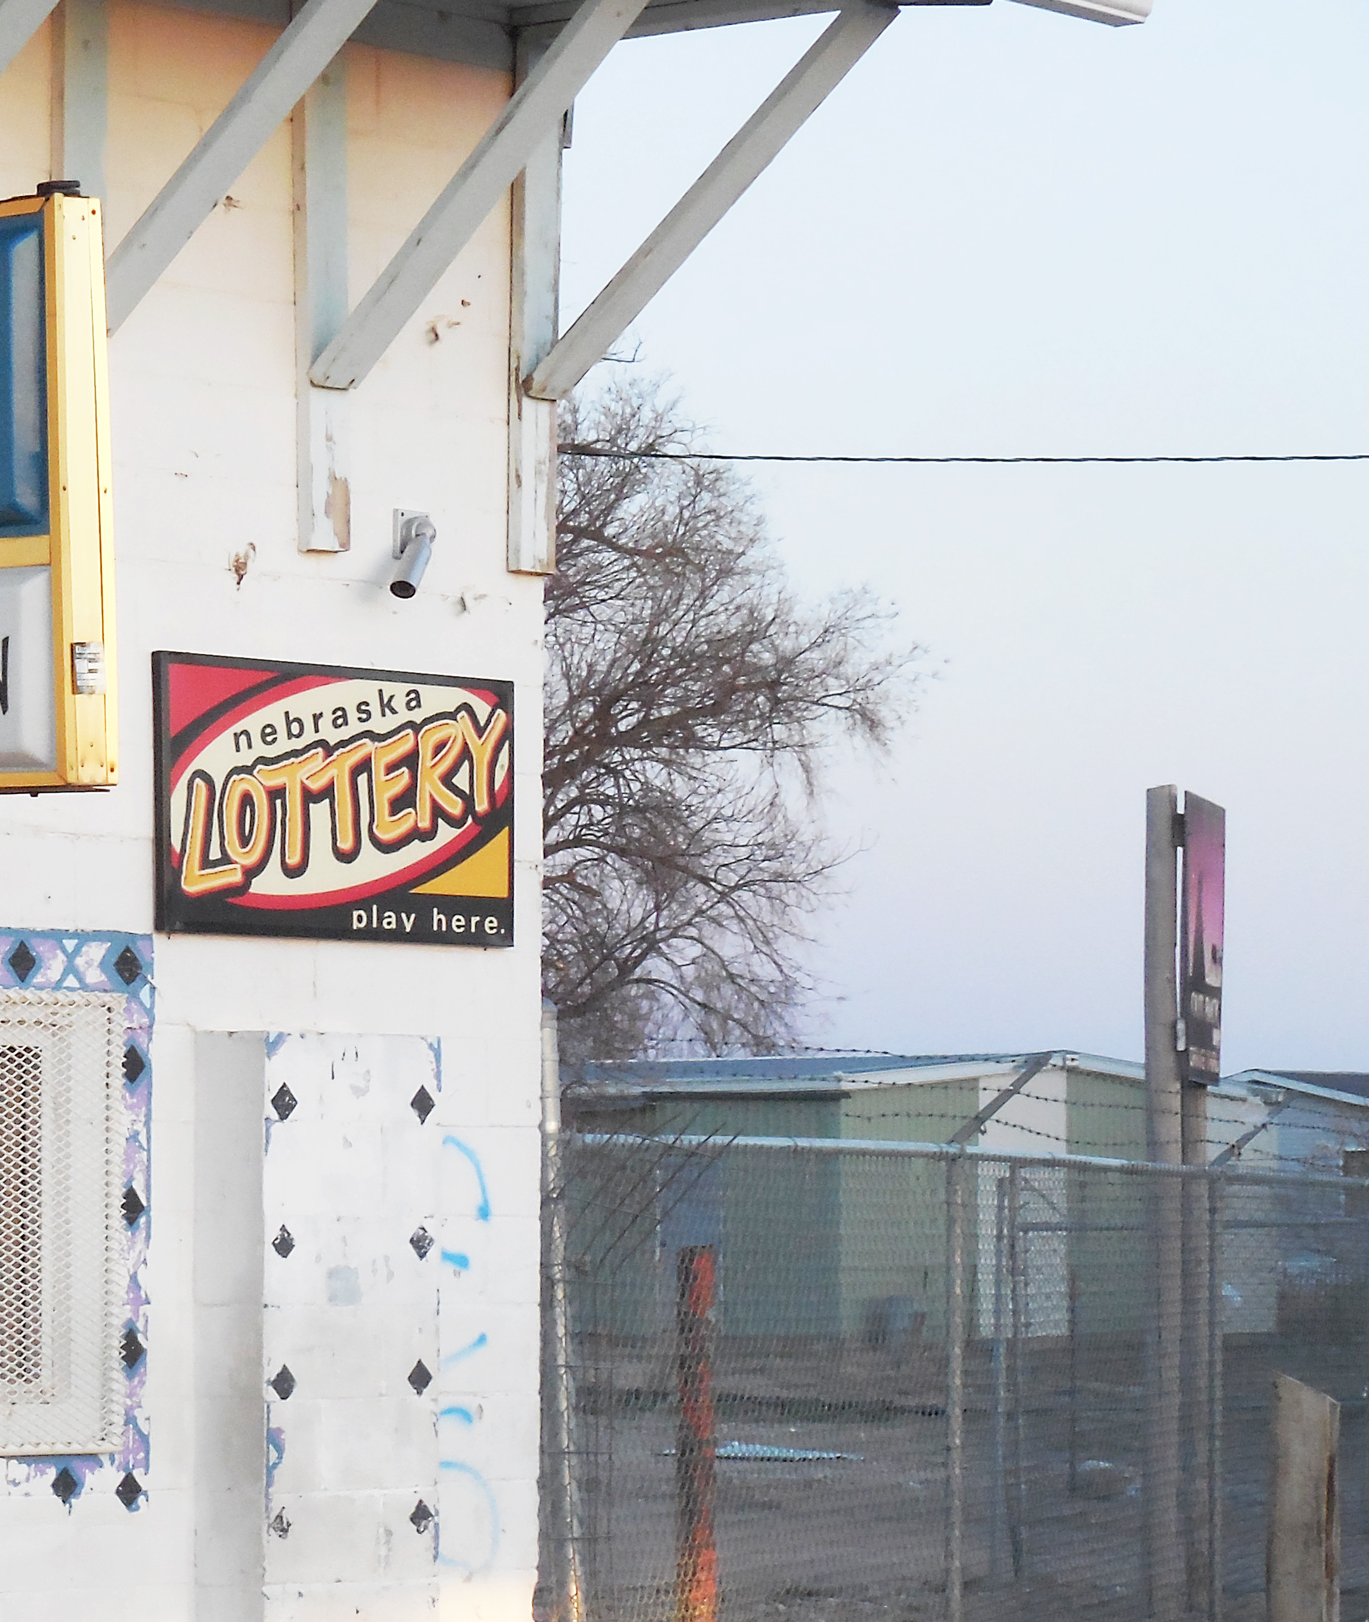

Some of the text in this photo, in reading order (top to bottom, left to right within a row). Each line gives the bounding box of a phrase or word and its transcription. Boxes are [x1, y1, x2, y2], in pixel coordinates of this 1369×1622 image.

[232, 687, 423, 753] nebraska
[180, 706, 508, 897] LOTTERY
[351, 905, 506, 935] play here.
